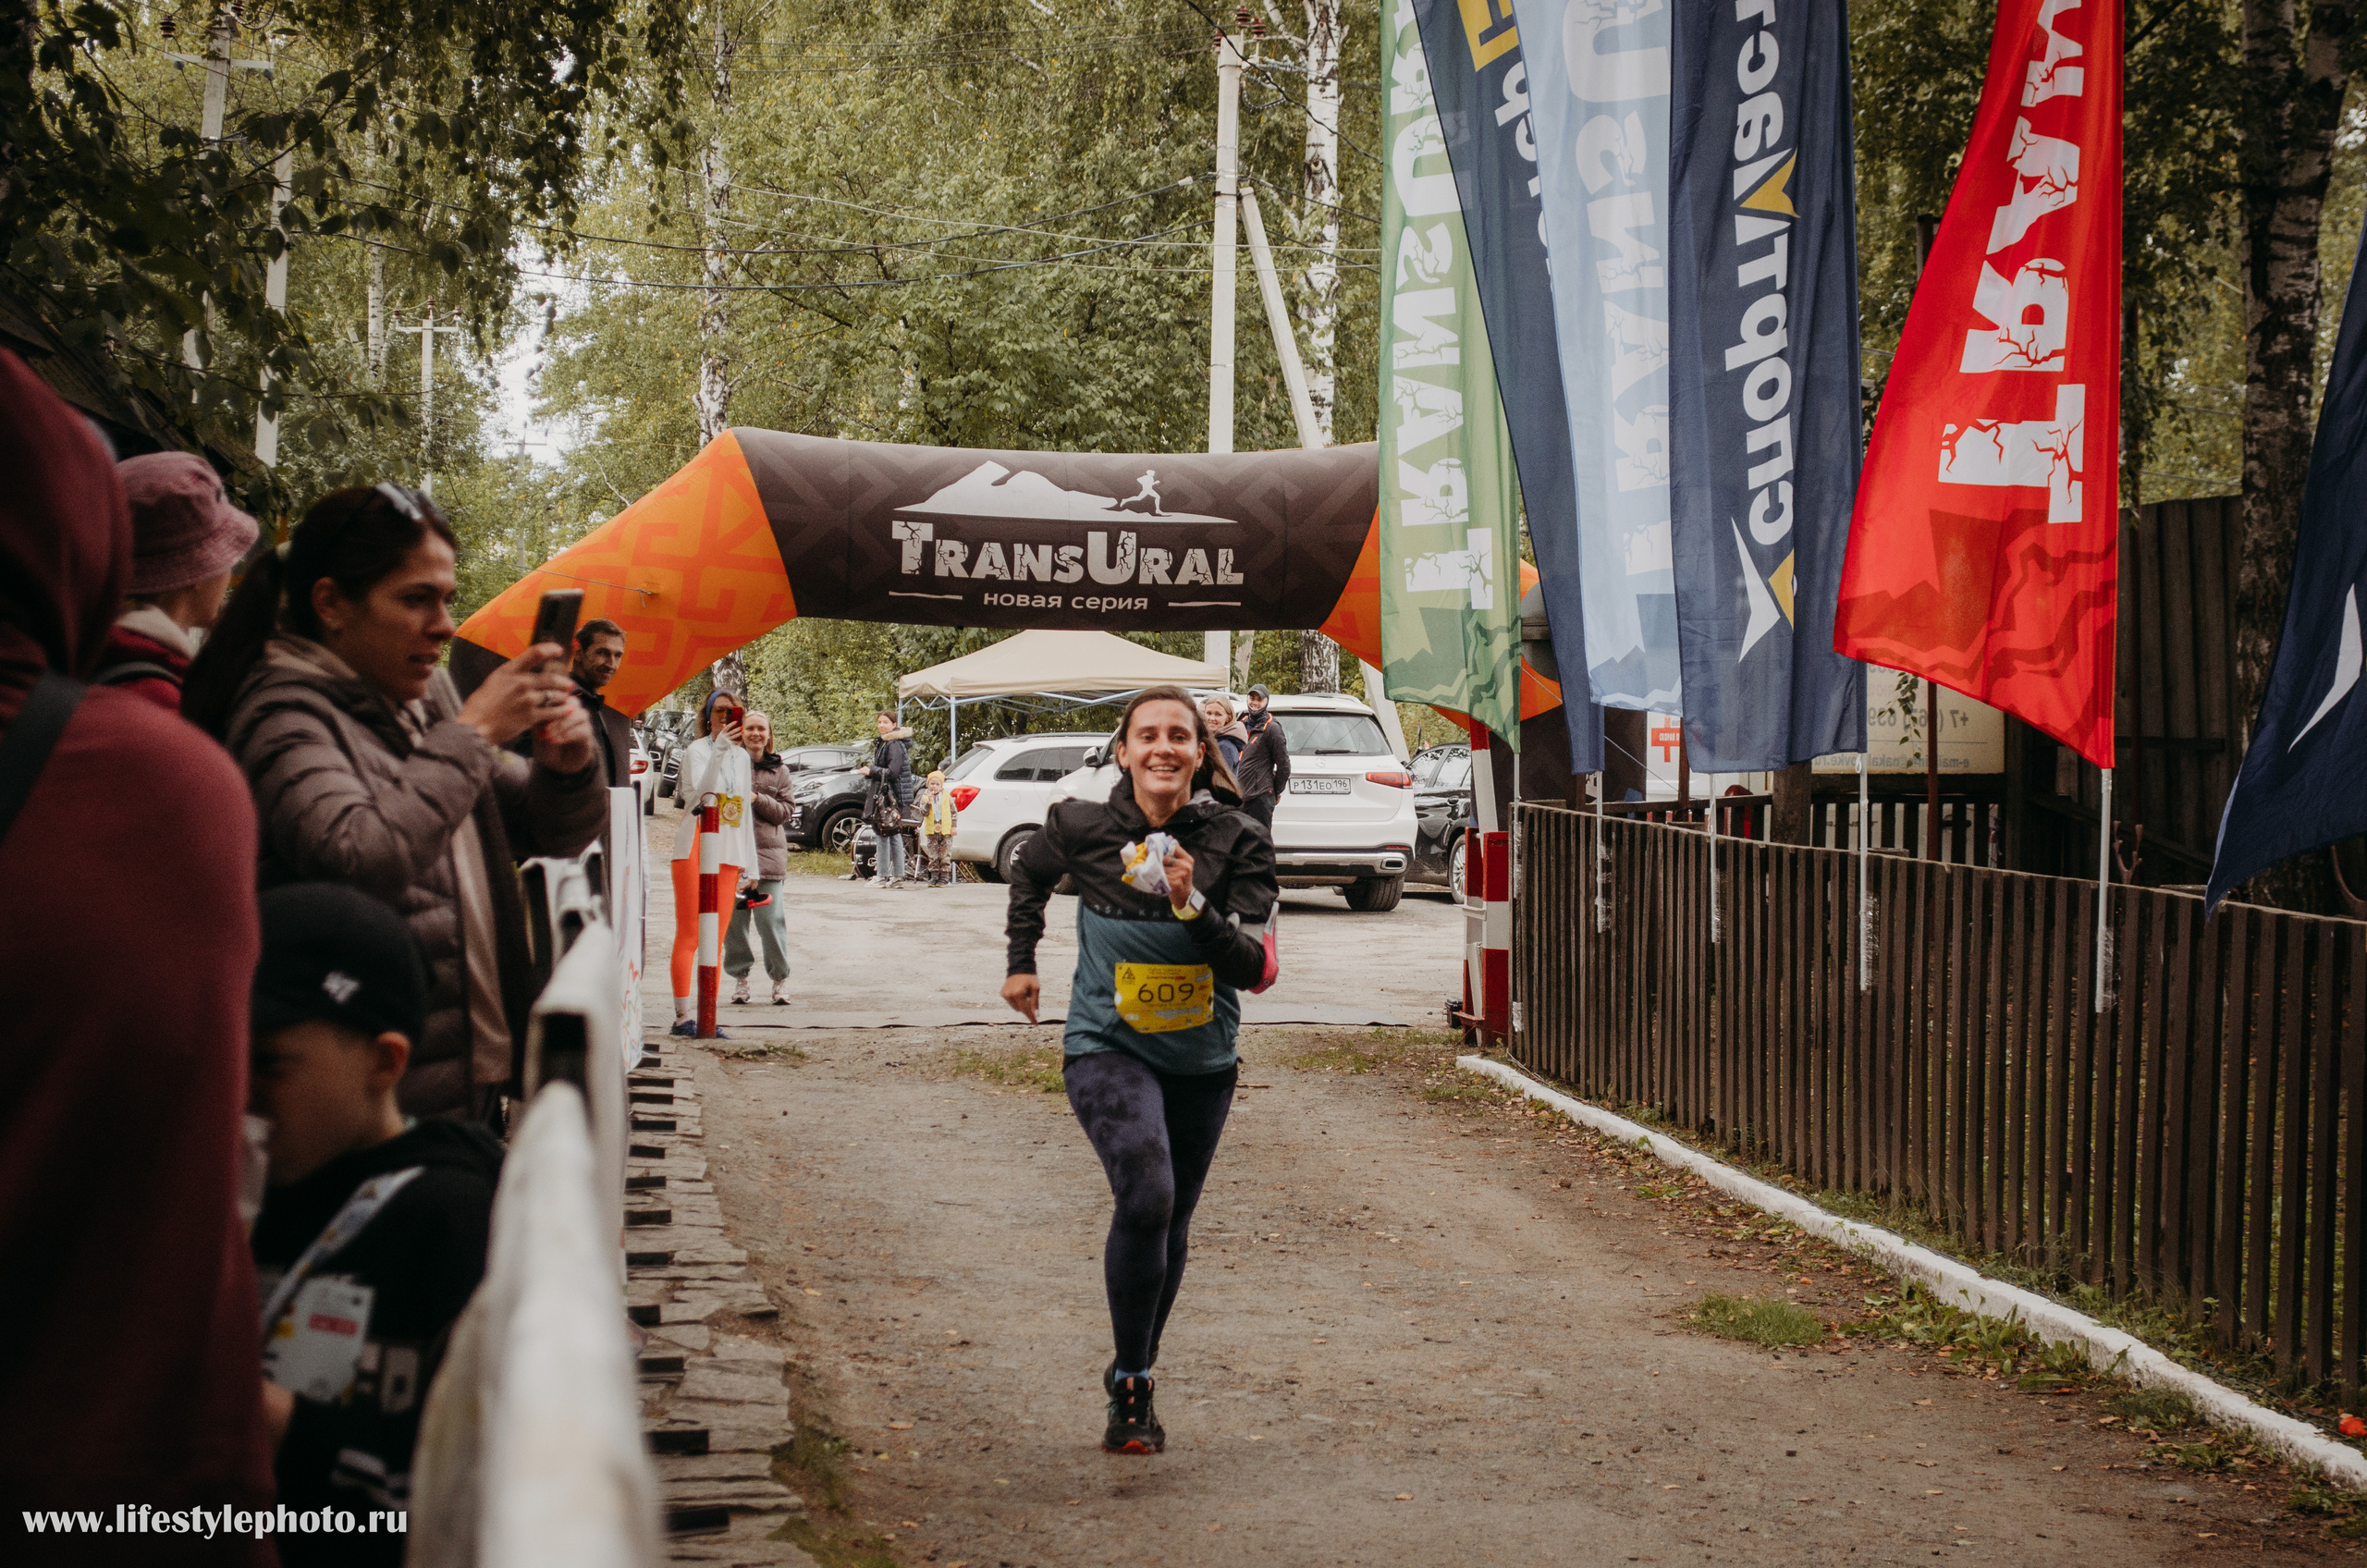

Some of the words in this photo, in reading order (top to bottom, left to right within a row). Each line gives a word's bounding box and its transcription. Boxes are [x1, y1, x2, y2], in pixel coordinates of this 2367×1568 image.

[983, 592, 1061, 608] новая
[1072, 594, 1148, 613] серия
[1138, 983, 1195, 1003] 609
